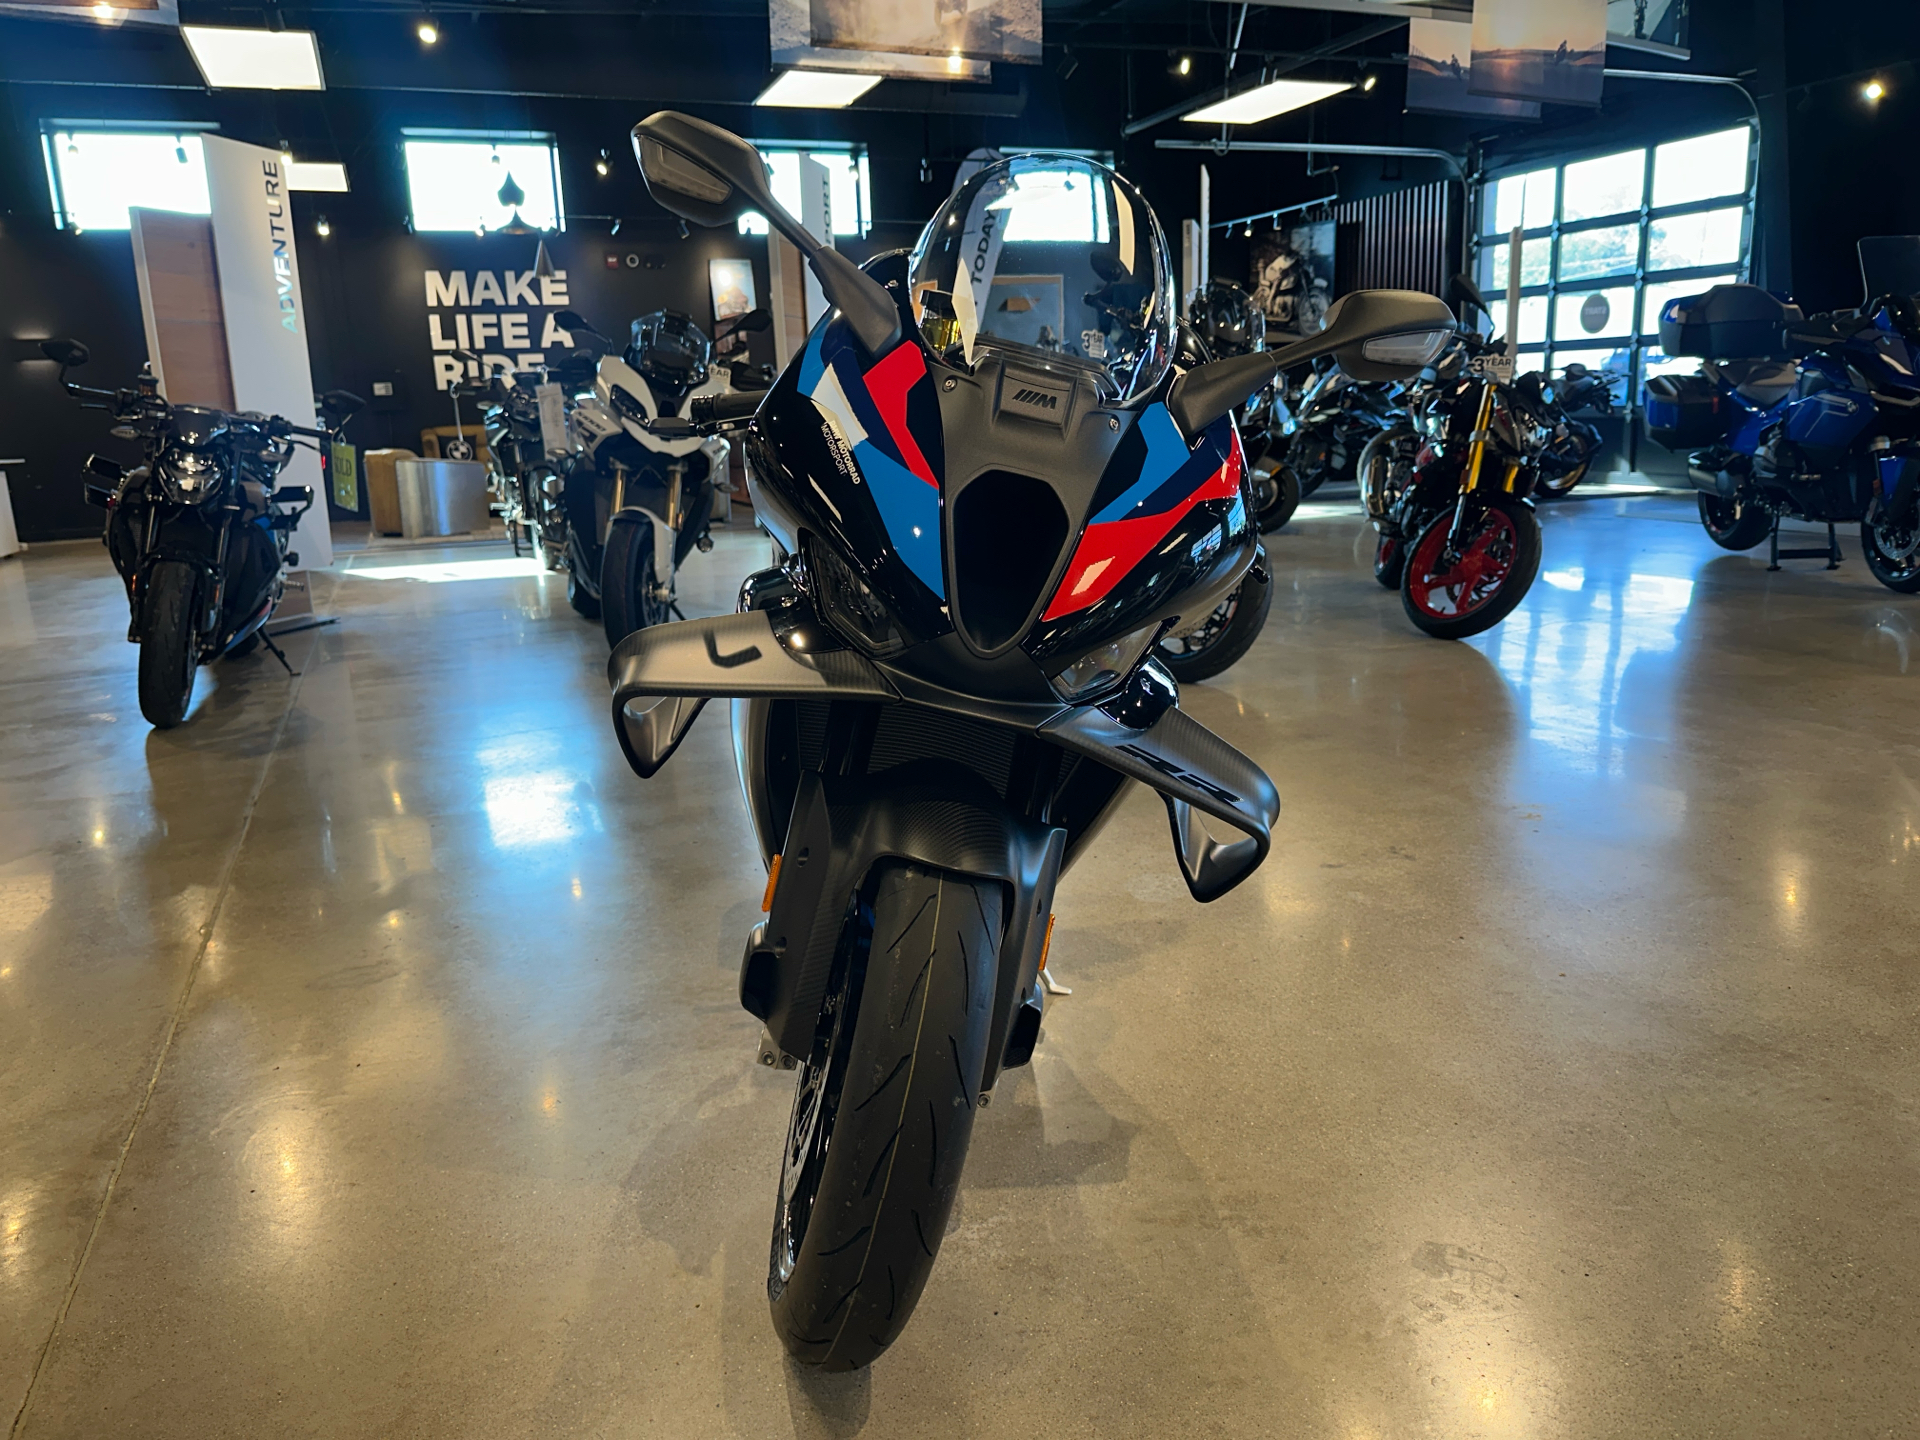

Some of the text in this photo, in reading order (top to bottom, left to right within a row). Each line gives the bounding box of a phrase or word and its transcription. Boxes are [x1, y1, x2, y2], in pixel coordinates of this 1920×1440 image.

[822, 174, 832, 245] PORT
[262, 160, 298, 333] ADVENTURE
[971, 210, 996, 284] TODAY
[425, 270, 570, 307] MAKE
[428, 313, 575, 350] LIFE A
[1083, 332, 1090, 349] 3
[710, 366, 729, 378] EAR
[1473, 356, 1512, 372] 3 YEAR
[821, 421, 848, 476] MOTORSPORT
[836, 439, 860, 485] MOTORRAD
